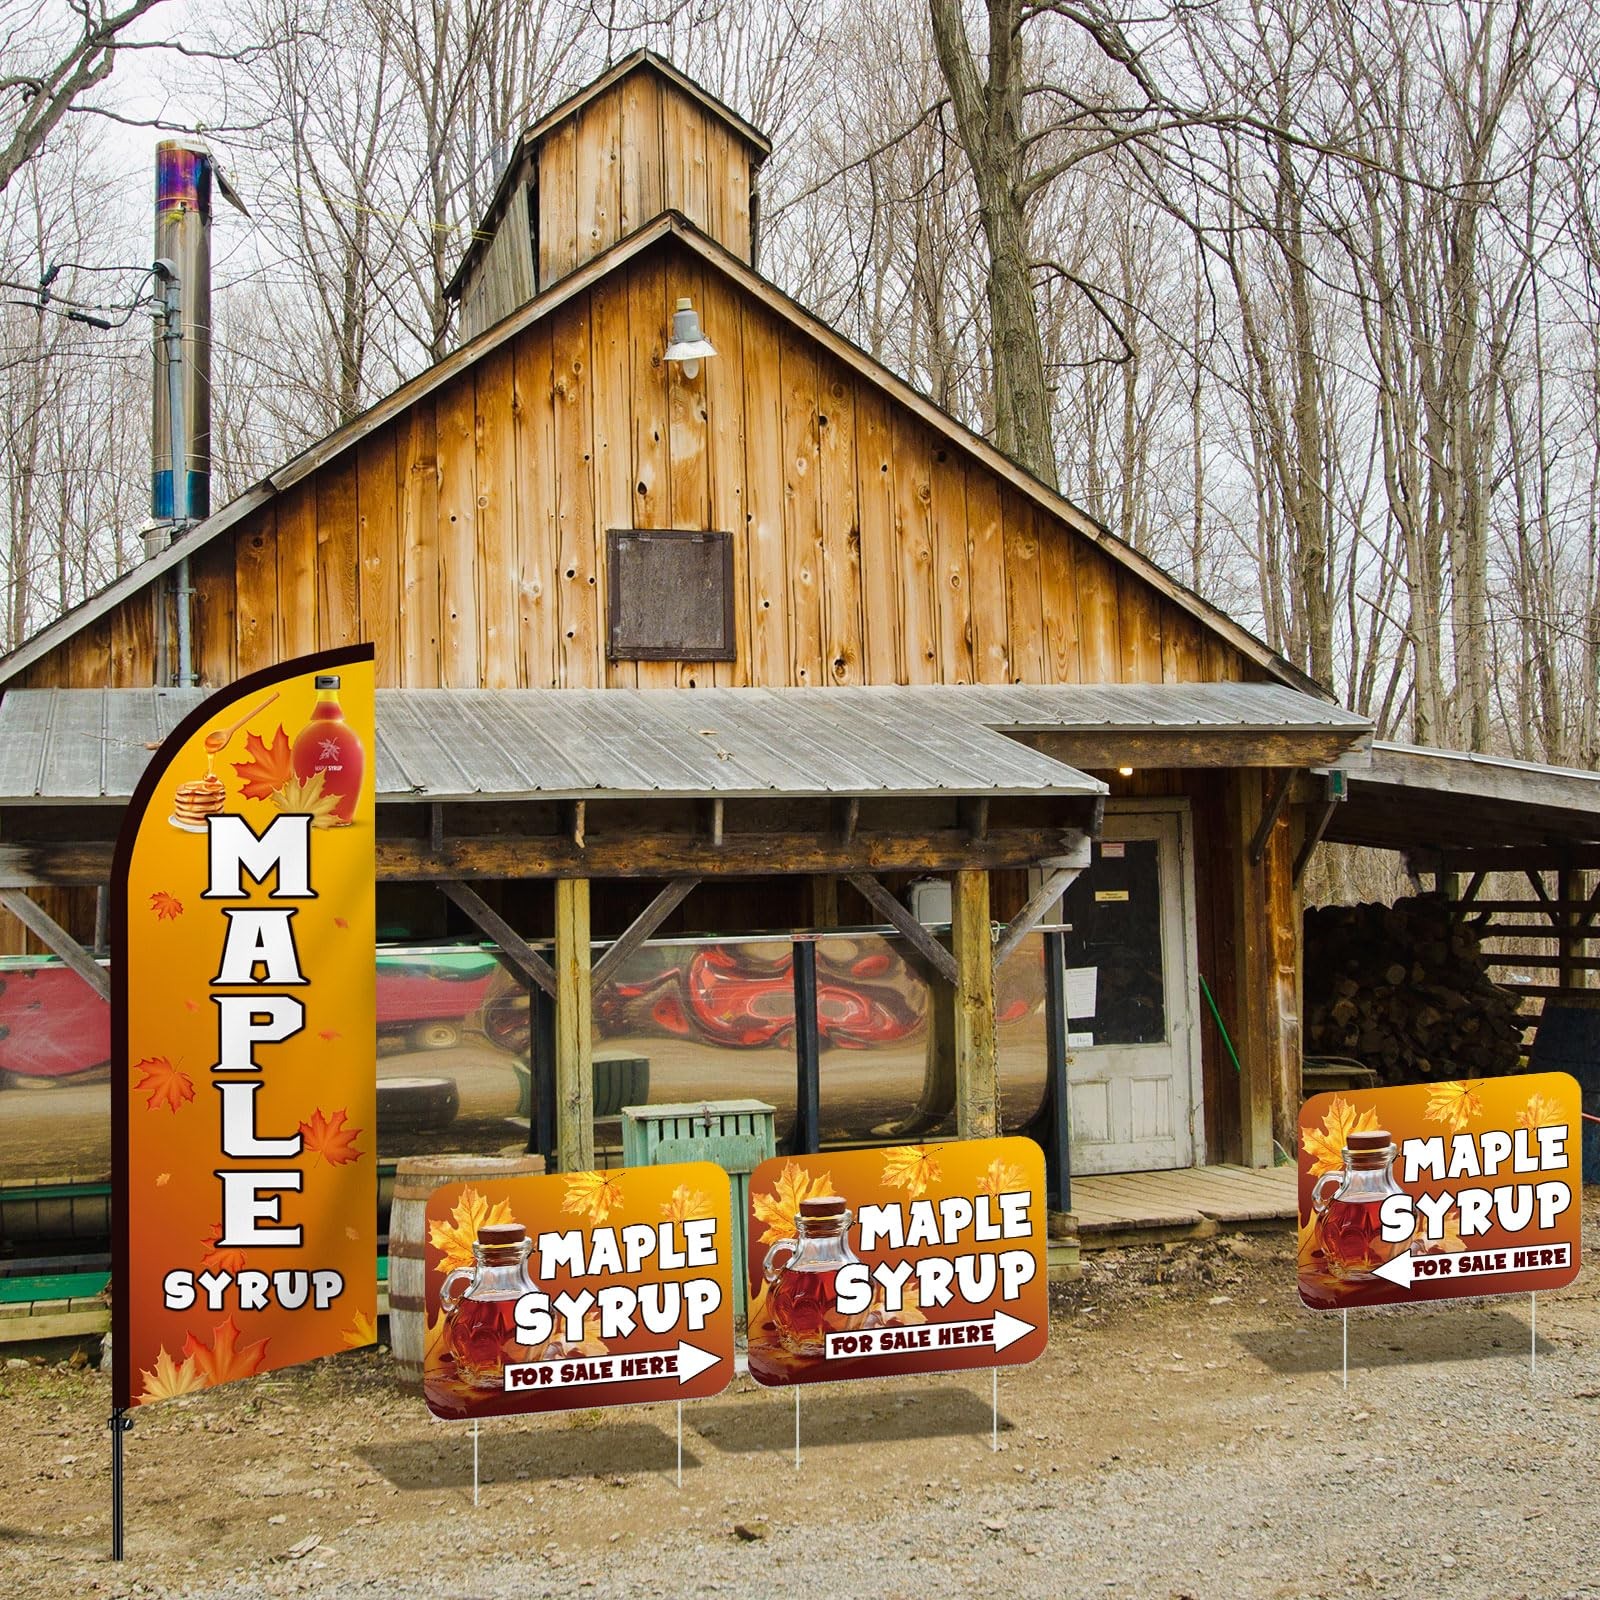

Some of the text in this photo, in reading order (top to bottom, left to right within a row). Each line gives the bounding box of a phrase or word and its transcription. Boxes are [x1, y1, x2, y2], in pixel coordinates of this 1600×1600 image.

[202, 814, 317, 1247] MAPLE
[1402, 1125, 1569, 1183] MAPLE
[858, 1191, 1032, 1251] MAPLE
[1379, 1181, 1572, 1243] SYRUP
[538, 1218, 718, 1280] MAPLE
[1413, 1248, 1567, 1277] FOR SALE HERE
[163, 1269, 345, 1311] SYRUP
[513, 1278, 722, 1345] SYRUP
[834, 1250, 1036, 1315] SYRUP
[831, 1323, 994, 1355] FOR SALE HERE
[510, 1354, 678, 1387] FOR SALE HERE
